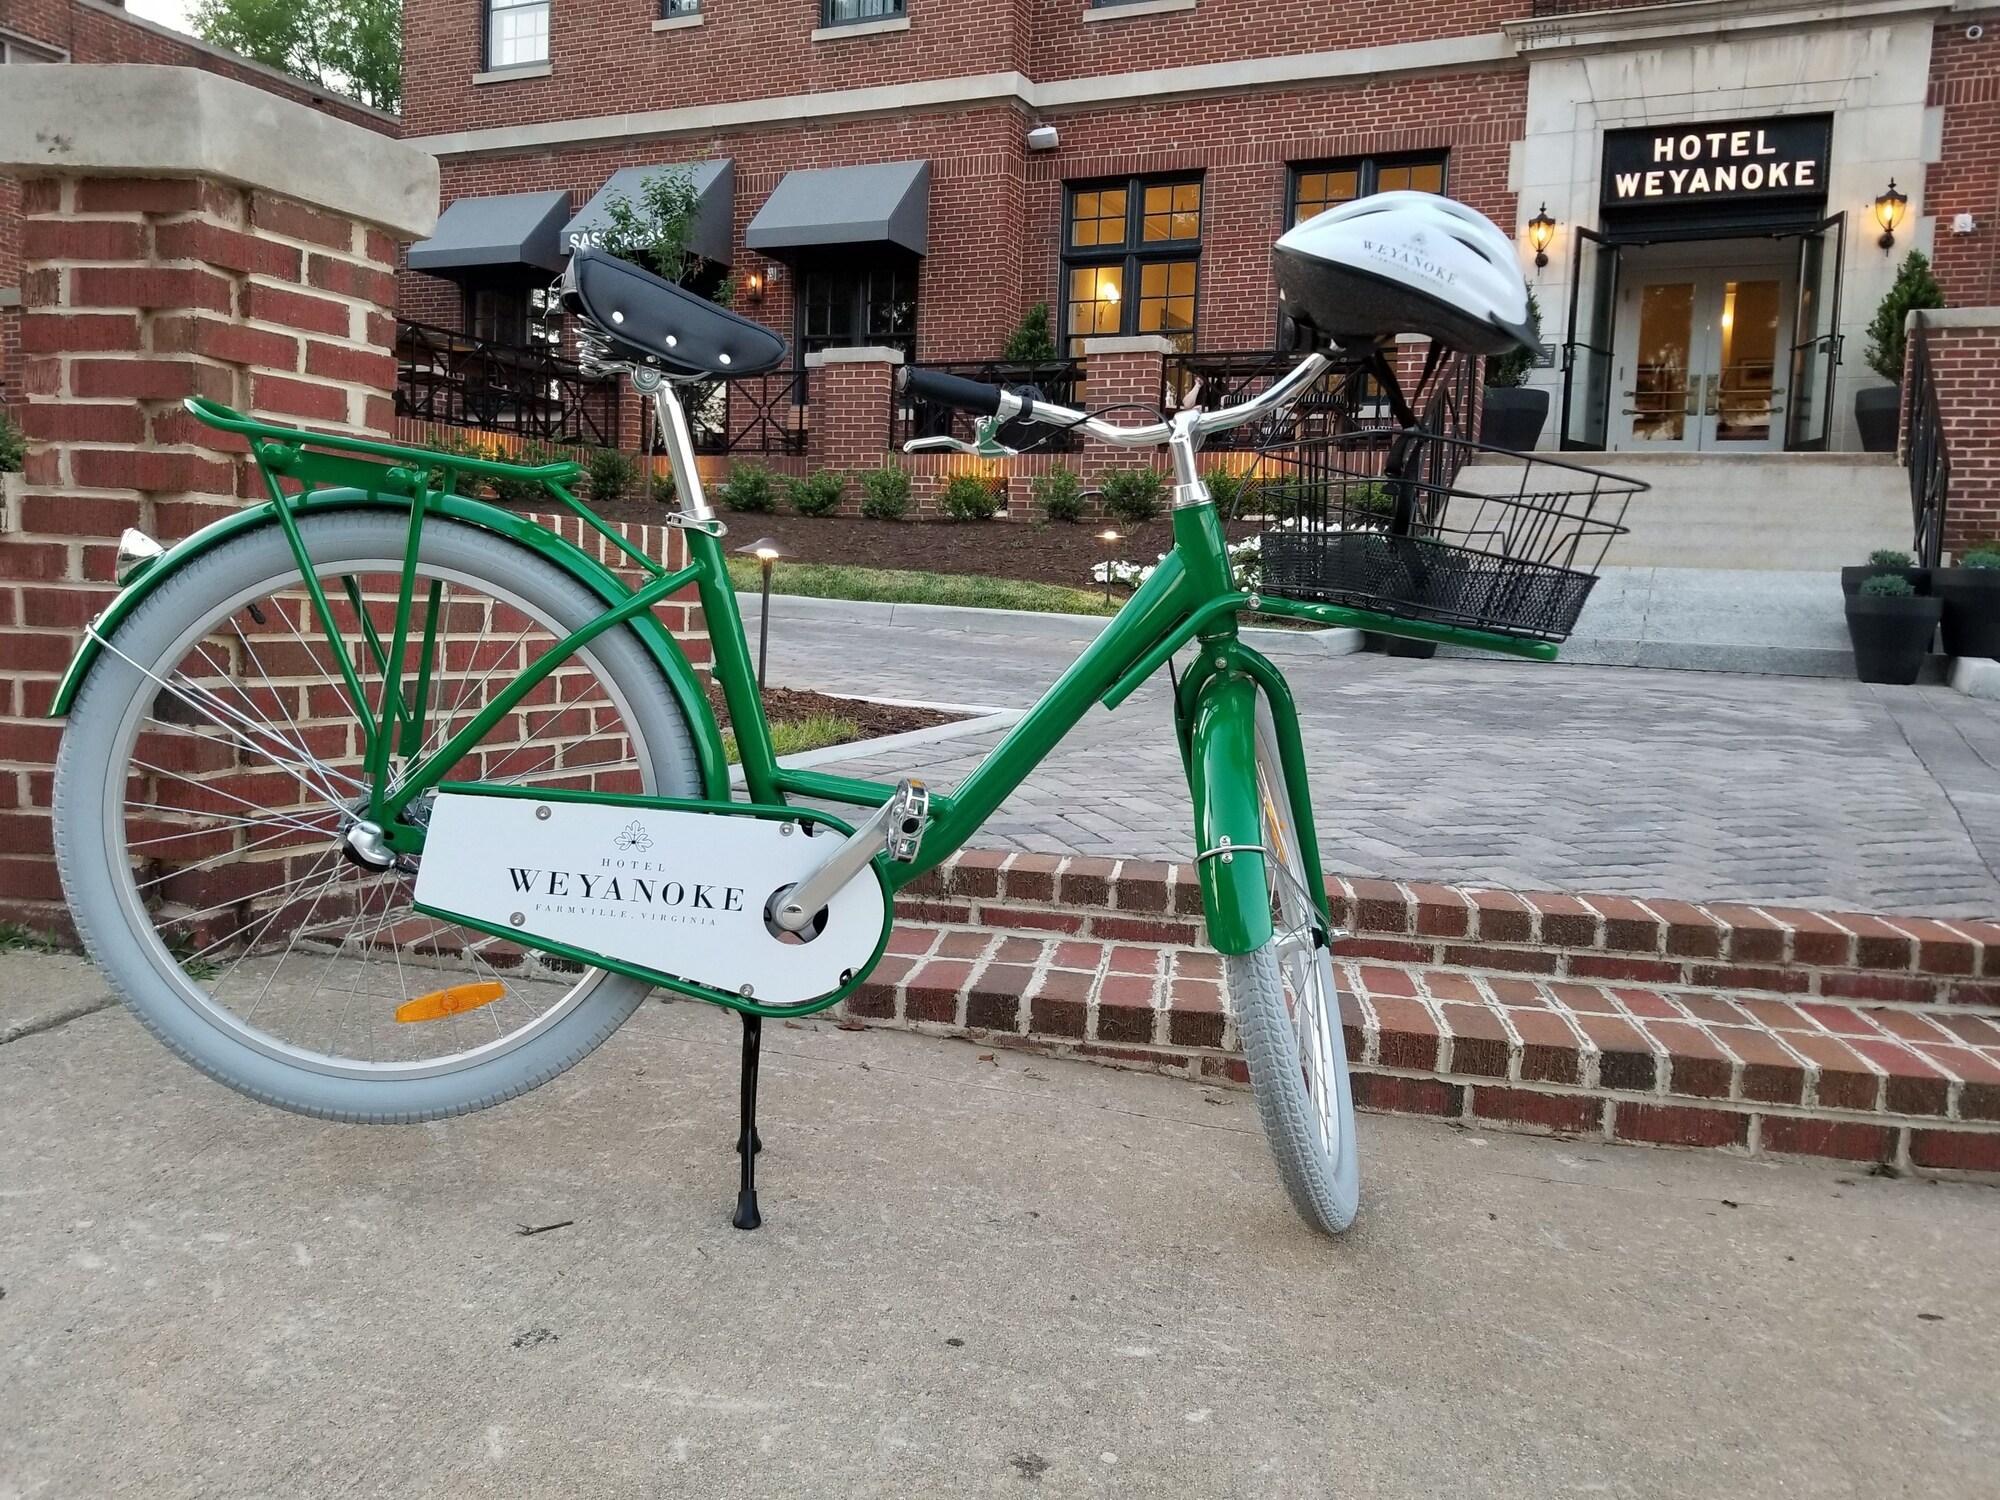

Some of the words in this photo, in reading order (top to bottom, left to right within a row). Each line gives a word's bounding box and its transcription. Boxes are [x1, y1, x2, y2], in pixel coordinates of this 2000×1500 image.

[1653, 129, 1776, 162] HOTEL
[1615, 160, 1816, 198] WEYANOKE
[1363, 240, 1458, 285] WEYANOKE
[600, 858, 666, 872] HOTEL
[507, 867, 745, 912] WEYANOKE
[641, 912, 716, 926] VIRGINIA
